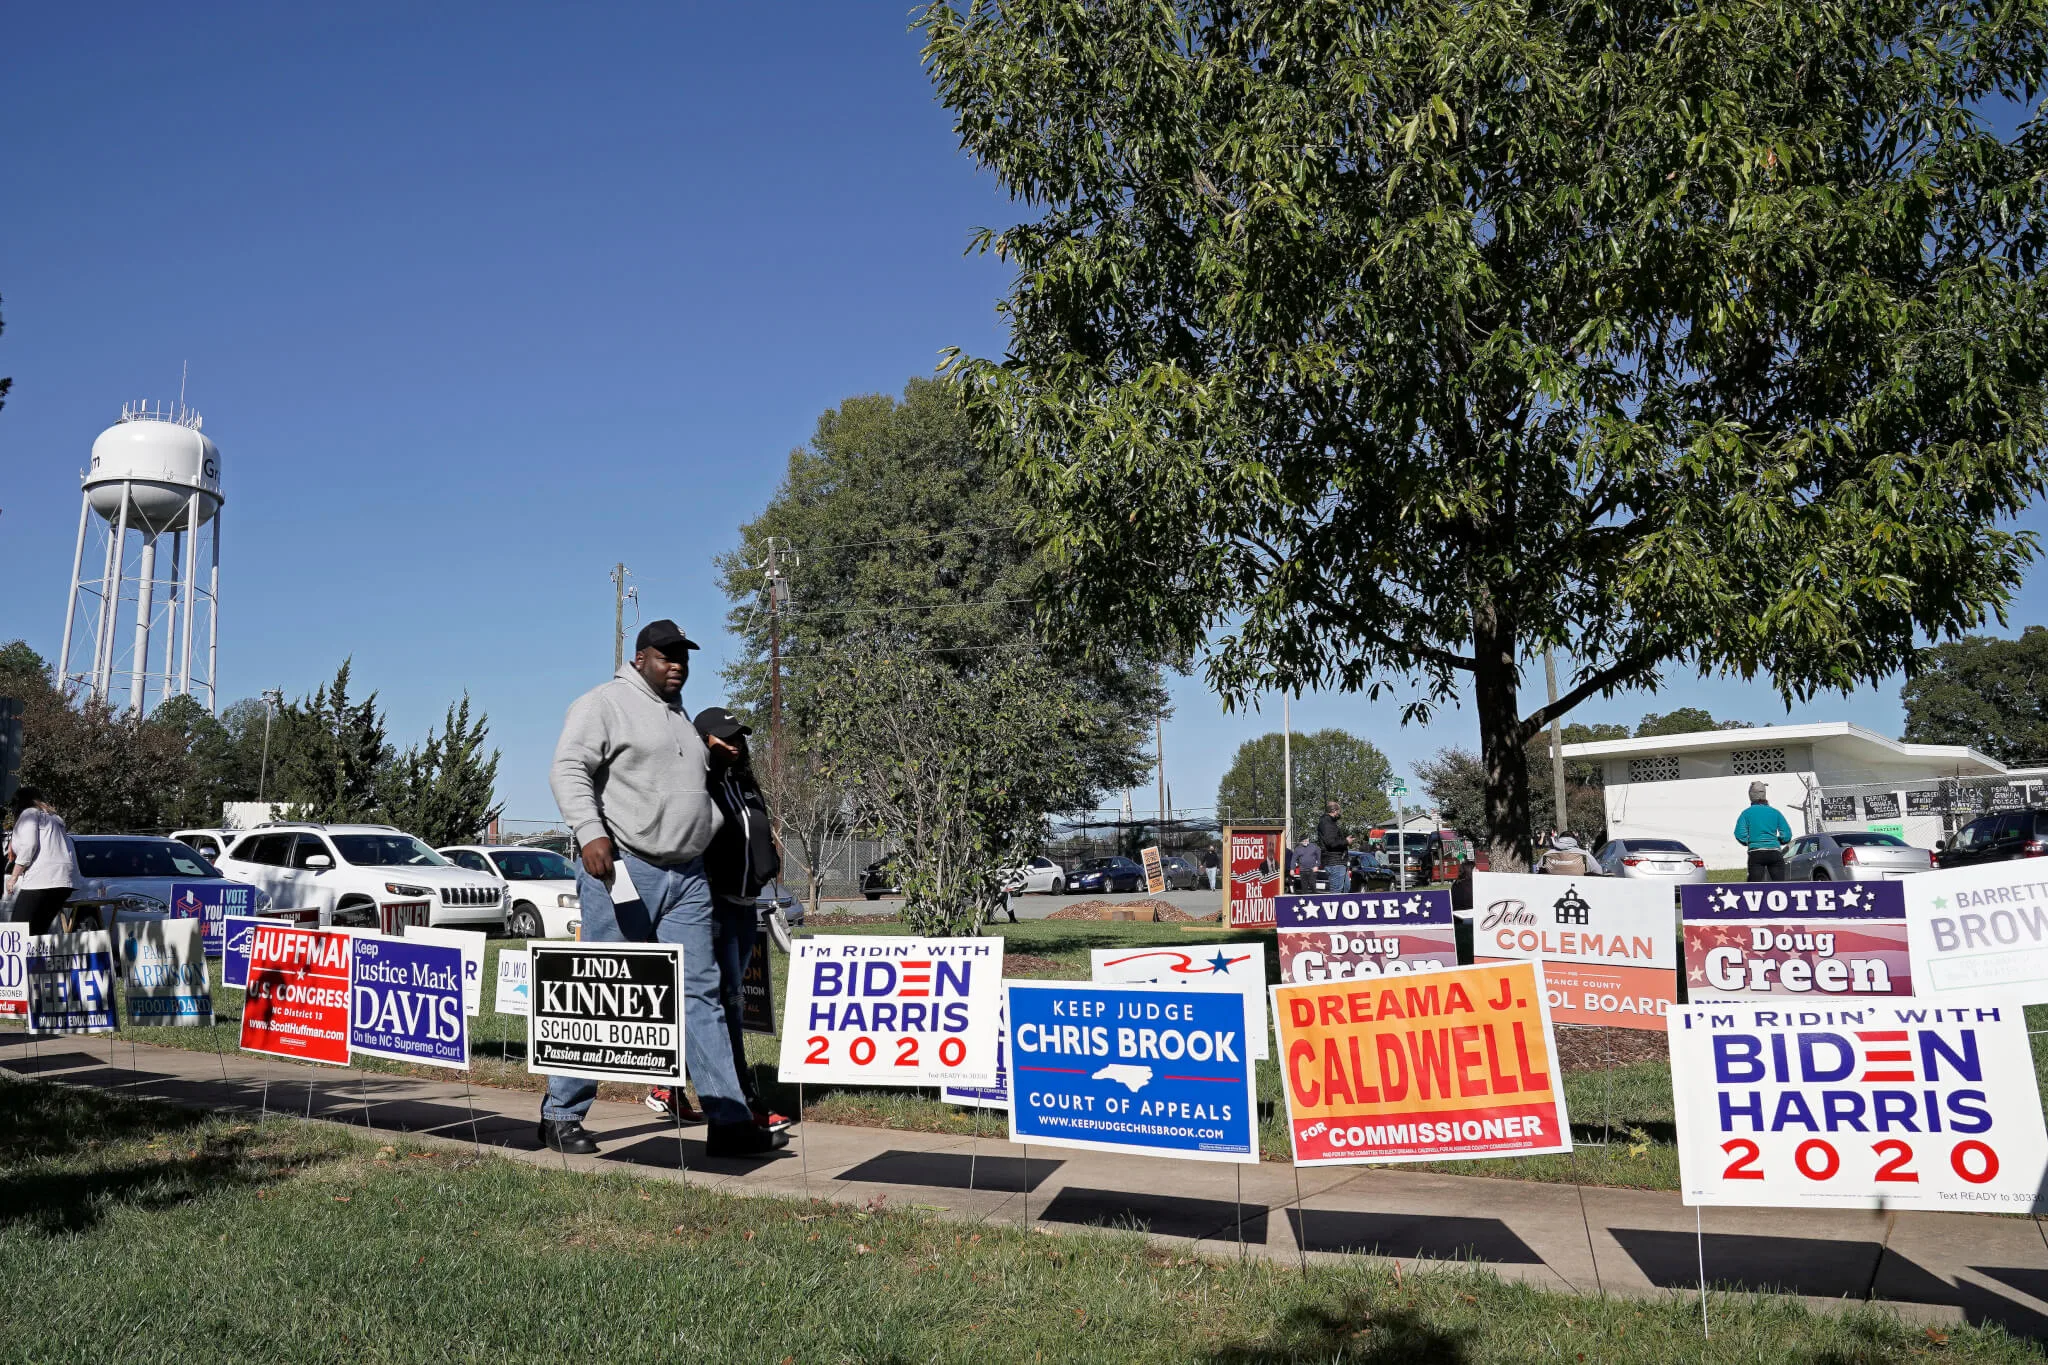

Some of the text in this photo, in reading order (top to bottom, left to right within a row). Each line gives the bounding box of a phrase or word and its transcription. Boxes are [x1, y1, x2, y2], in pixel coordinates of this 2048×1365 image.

[1949, 788, 1983, 797] BLACK
[1231, 845, 1264, 863] JUDGE
[1232, 836, 1264, 845] District Court
[220, 888, 248, 904] I VOTE
[1246, 881, 1263, 898] Rick
[1743, 889, 1836, 911] VOTE
[1956, 882, 2048, 909] BARRETT
[205, 904, 247, 920] YOU VOTE
[1321, 899, 1400, 920] VOTE
[1480, 899, 1539, 931] John
[1, 930, 21, 954] OB
[201, 921, 224, 937] #WE
[1930, 906, 2048, 951] BROW
[253, 930, 350, 969] HUFFMAN
[355, 940, 379, 959] Keep
[801, 944, 990, 957] I'M RIDIN' WITH
[1329, 933, 1400, 959] Doug
[1495, 928, 1653, 959] COLEMAN
[1750, 927, 1835, 958] Doug
[354, 956, 459, 991] Justice Mark
[571, 957, 632, 979] LINDA
[812, 961, 972, 997] BIDEN
[1291, 951, 1444, 983] Gre
[1704, 946, 1893, 992] Green
[29, 970, 110, 1013] FEELEY
[249, 979, 350, 1009] U.S. CONGRESS
[1582, 980, 1622, 989] COUNTY
[131, 999, 211, 1013] CHOOL BOARD
[541, 980, 669, 1018] KINNEY
[1053, 1000, 1194, 1021] KEEP JUDGE
[1289, 978, 1527, 1028] DREAMA J.
[1583, 992, 1672, 1017] BOARD
[67, 1015, 107, 1027] EDUCATION
[271, 1007, 282, 1015] NC
[284, 1007, 313, 1019] District
[353, 985, 461, 1043] DAVIS
[809, 1002, 969, 1032] HARRIS
[1683, 1007, 2001, 1029] I'M RIDIN' WITH
[249, 1019, 344, 1040] www.ScottHuffman.com
[541, 1019, 670, 1046] SCHOOL BOARD
[1016, 1023, 1240, 1063] CHRIS BROOK
[353, 1030, 461, 1058] On the NC Supreme Court
[544, 1044, 666, 1068] Passion and Dedication
[804, 1035, 967, 1067] 2020
[1711, 1029, 1983, 1083] BIDEN
[1289, 1021, 1550, 1108] CALDWELL
[1029, 1092, 1232, 1121] COURT OF APPEALS
[1717, 1089, 1993, 1134] HARRIS
[1038, 1115, 1224, 1140] WWW.KEEPJUDGECHRISBROOK.COM
[1299, 1115, 1544, 1148] FOR COMMISSIONER
[1720, 1138, 1999, 1184] 2020
[1937, 1191, 1958, 1200] Text
[1961, 1191, 1996, 1201] READY
[2000, 1192, 2010, 1201] to
